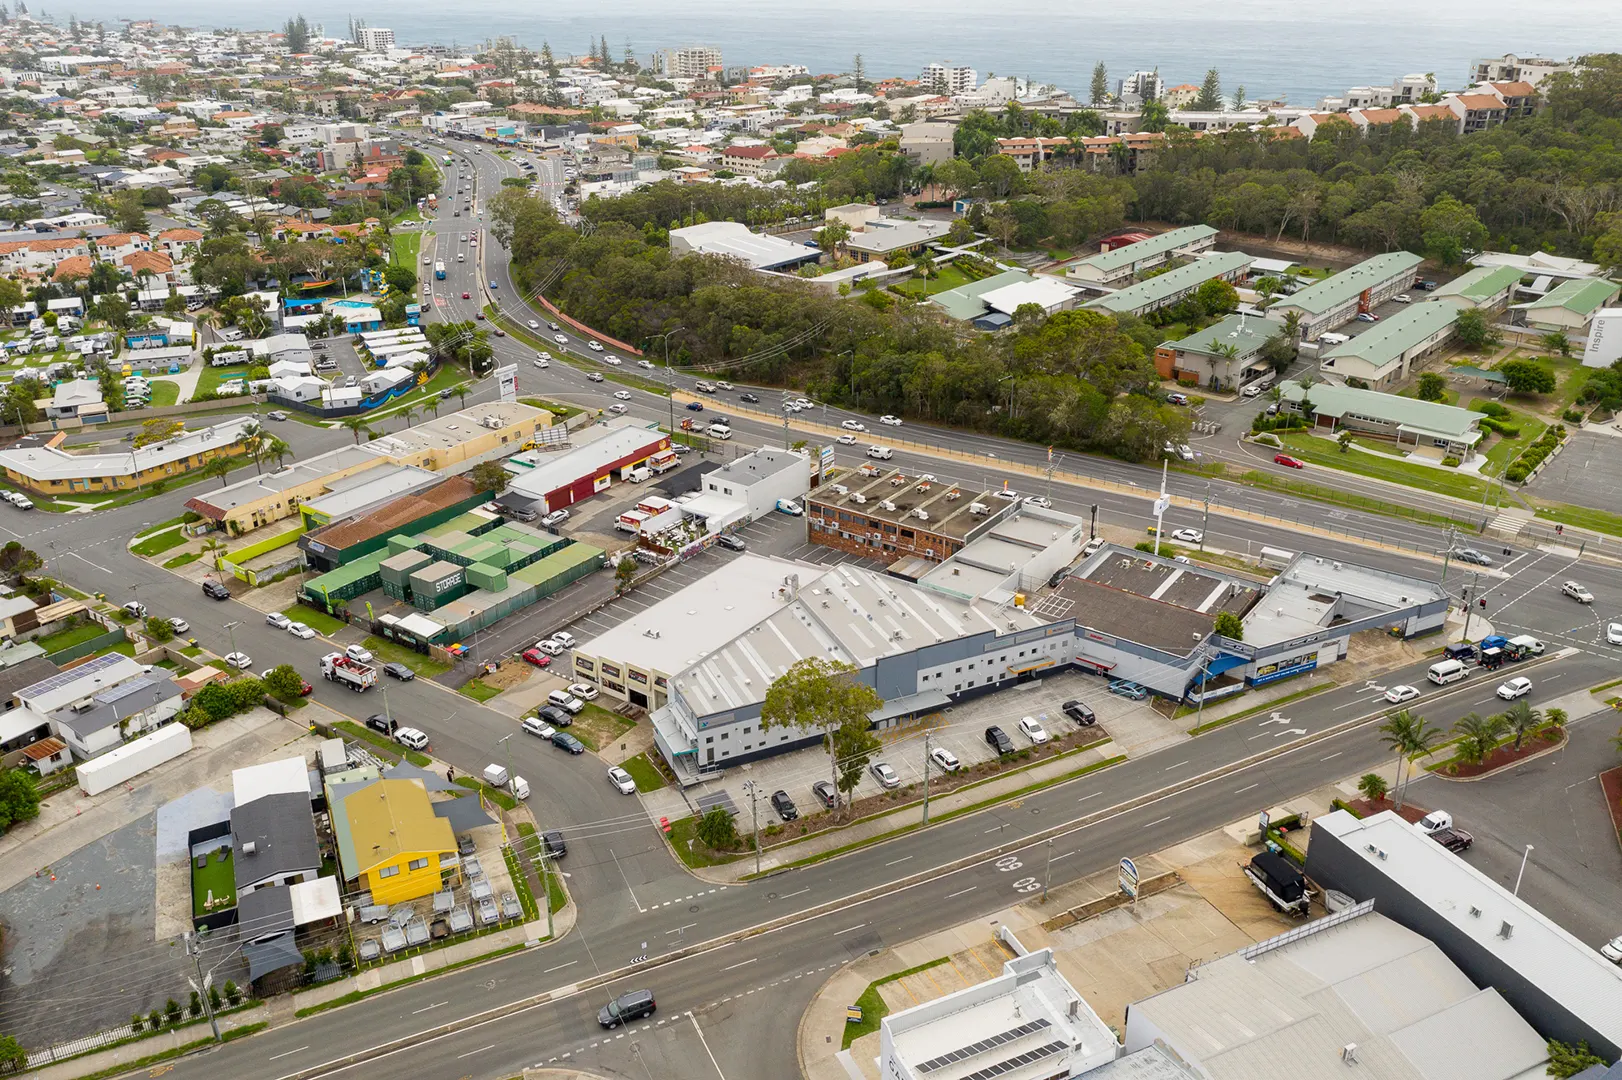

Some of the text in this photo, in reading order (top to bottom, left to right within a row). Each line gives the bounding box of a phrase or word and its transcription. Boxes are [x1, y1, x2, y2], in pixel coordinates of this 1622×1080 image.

[1589, 319, 1606, 352] Inspire
[435, 572, 462, 592] STORAGE
[995, 856, 1023, 872] 60
[1012, 876, 1041, 893] 60
